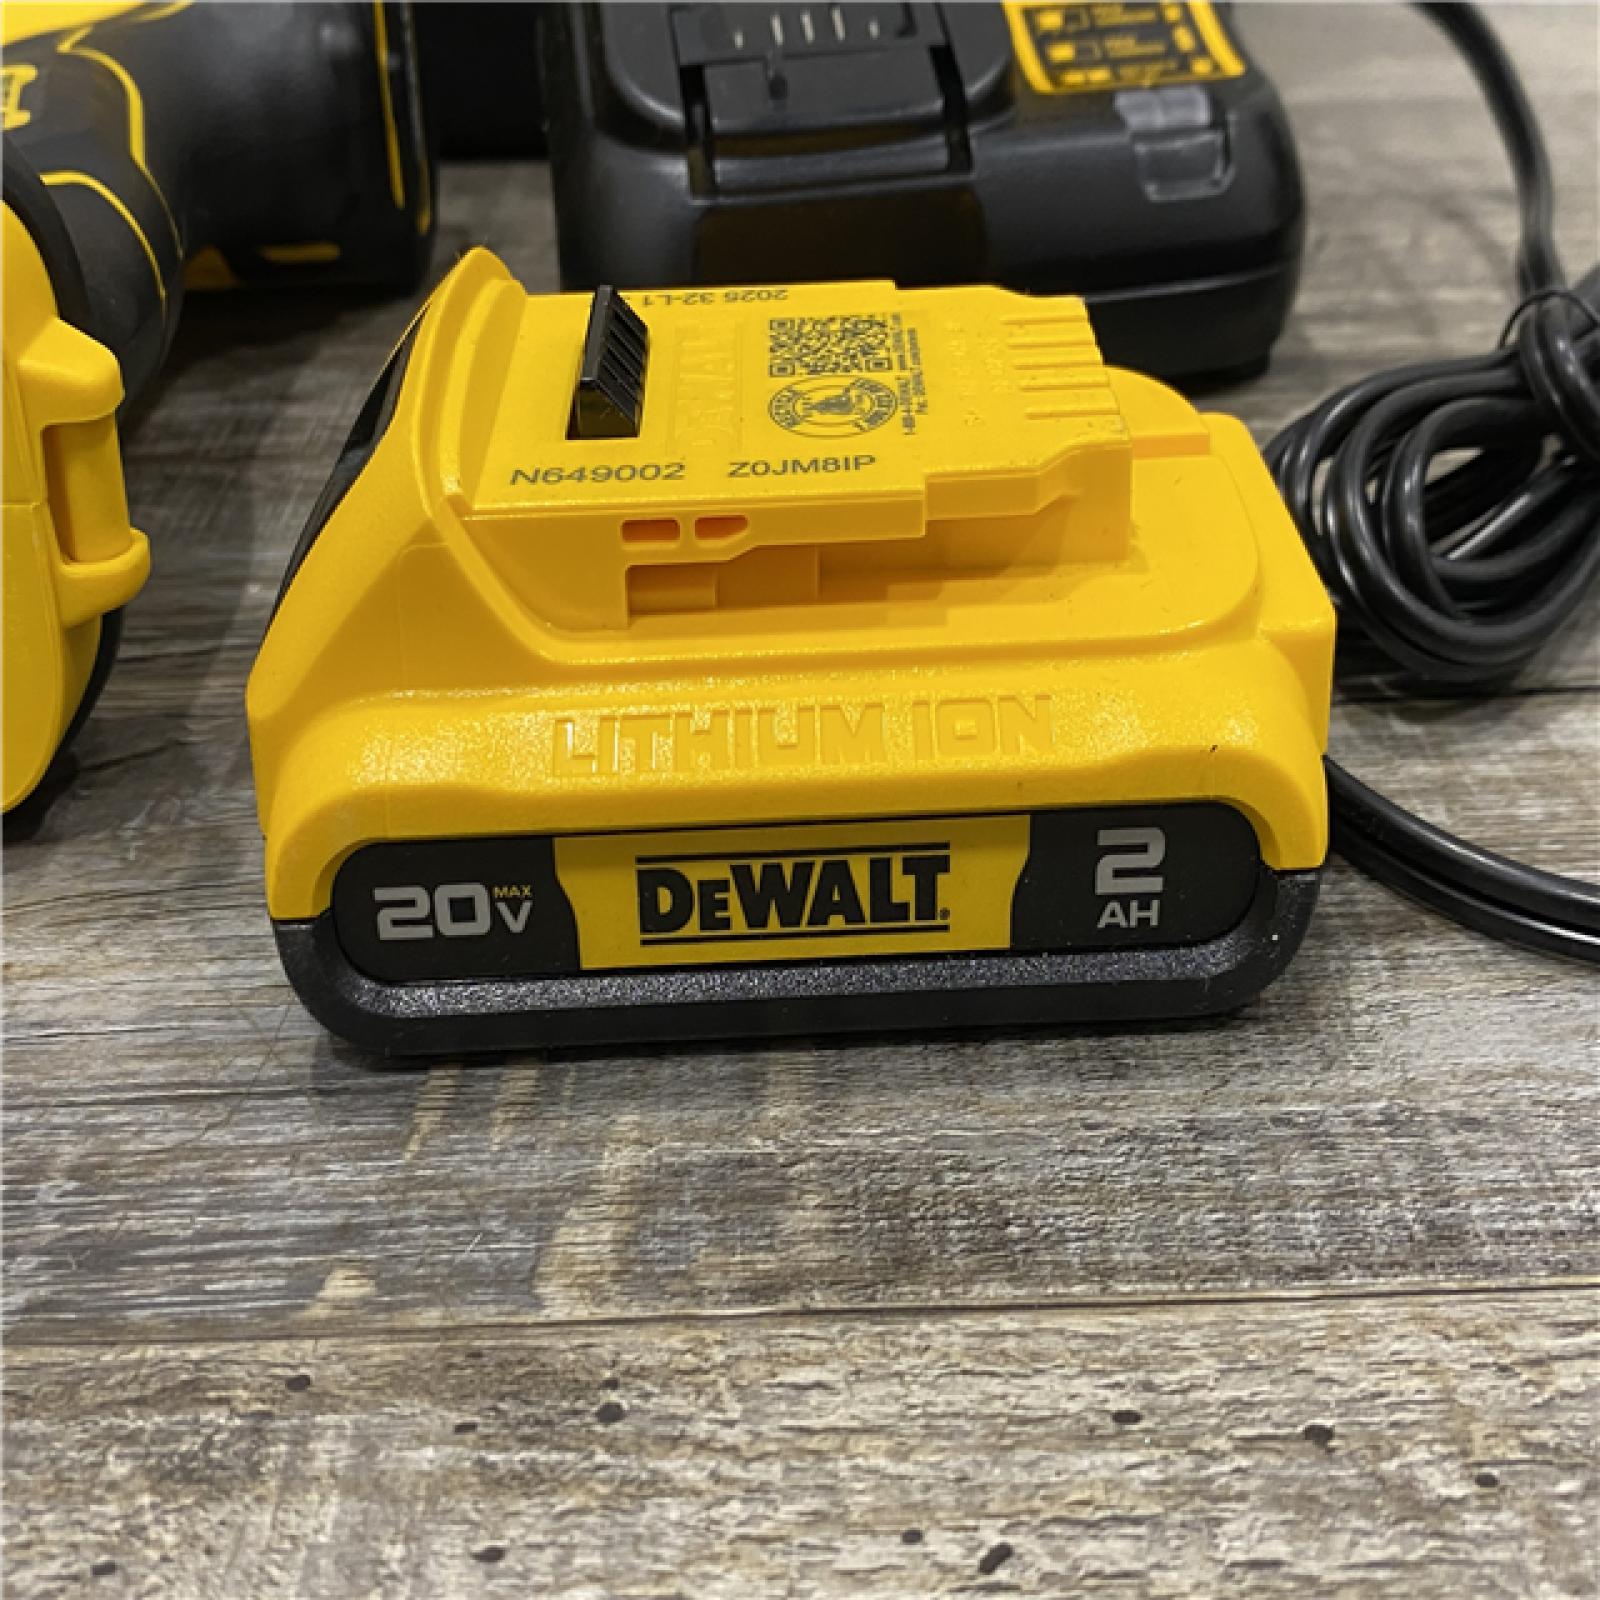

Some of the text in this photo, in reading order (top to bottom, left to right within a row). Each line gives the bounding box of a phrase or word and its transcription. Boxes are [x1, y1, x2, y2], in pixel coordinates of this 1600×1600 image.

[509, 461, 687, 486] N649002
[551, 694, 1055, 777] LITHIUM ION
[1094, 826, 1167, 897] 2
[493, 885, 533, 899] MAX
[1096, 898, 1160, 930] AH
